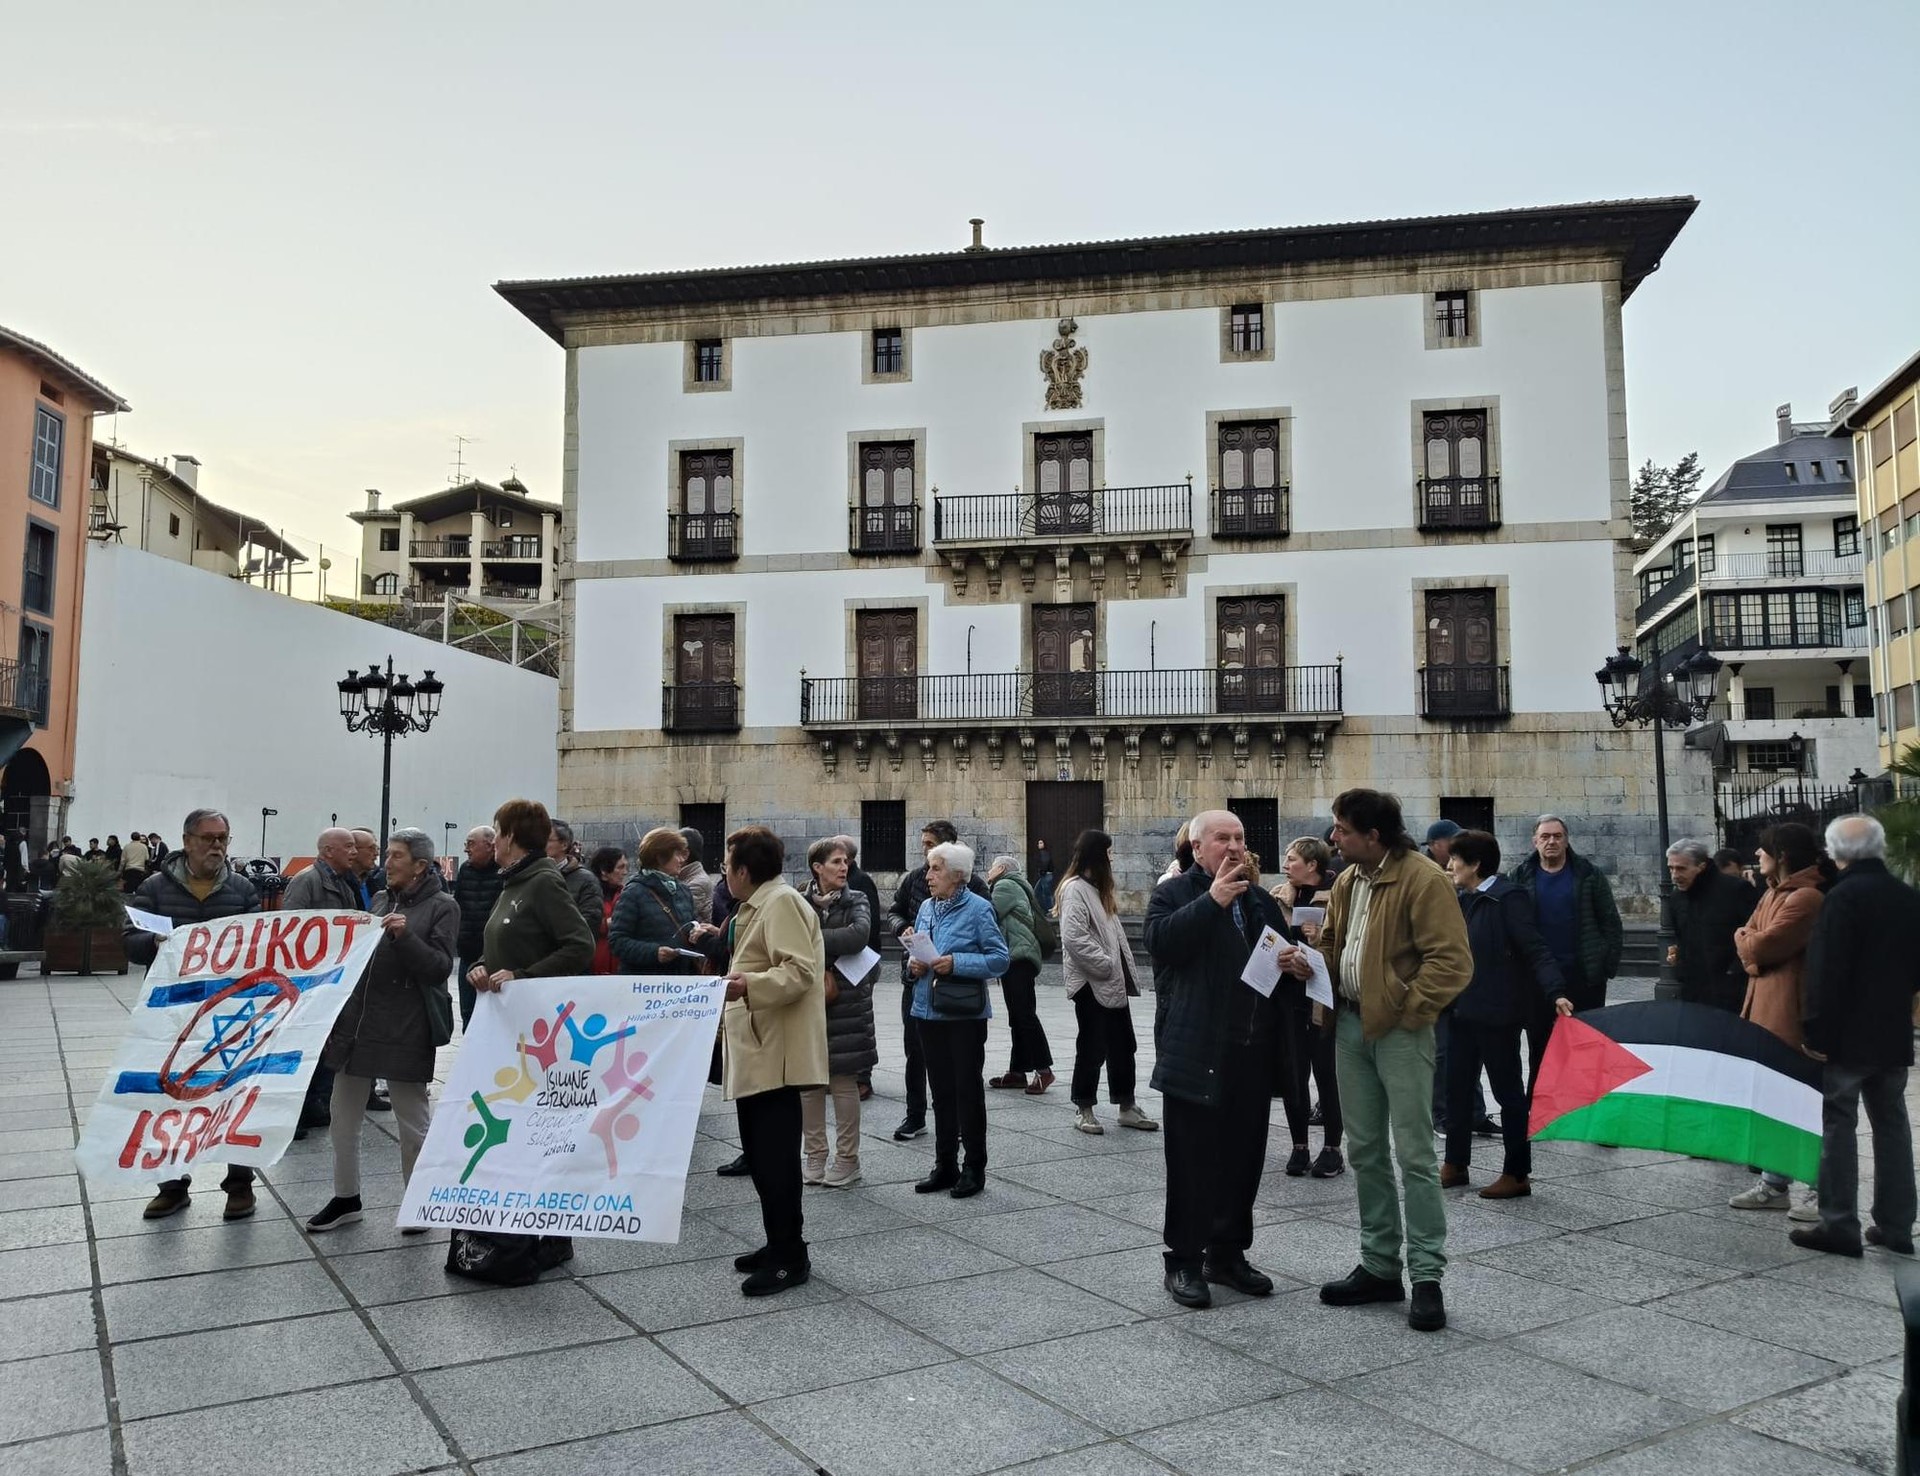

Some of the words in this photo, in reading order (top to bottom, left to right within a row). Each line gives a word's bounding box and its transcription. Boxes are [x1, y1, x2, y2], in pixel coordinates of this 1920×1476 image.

[178, 915, 370, 977] BOIKOT
[632, 982, 682, 994] Herriko
[671, 1007, 718, 1020] osteguna
[428, 1186, 499, 1206] HARRERA
[503, 1192, 531, 1209] ETA
[535, 1192, 589, 1211] ABEGI
[593, 1194, 634, 1212] ONA
[416, 1204, 495, 1226] INCLUSIÓN
[499, 1210, 510, 1227] Y
[510, 1211, 641, 1234] HOSPITALIDAD
